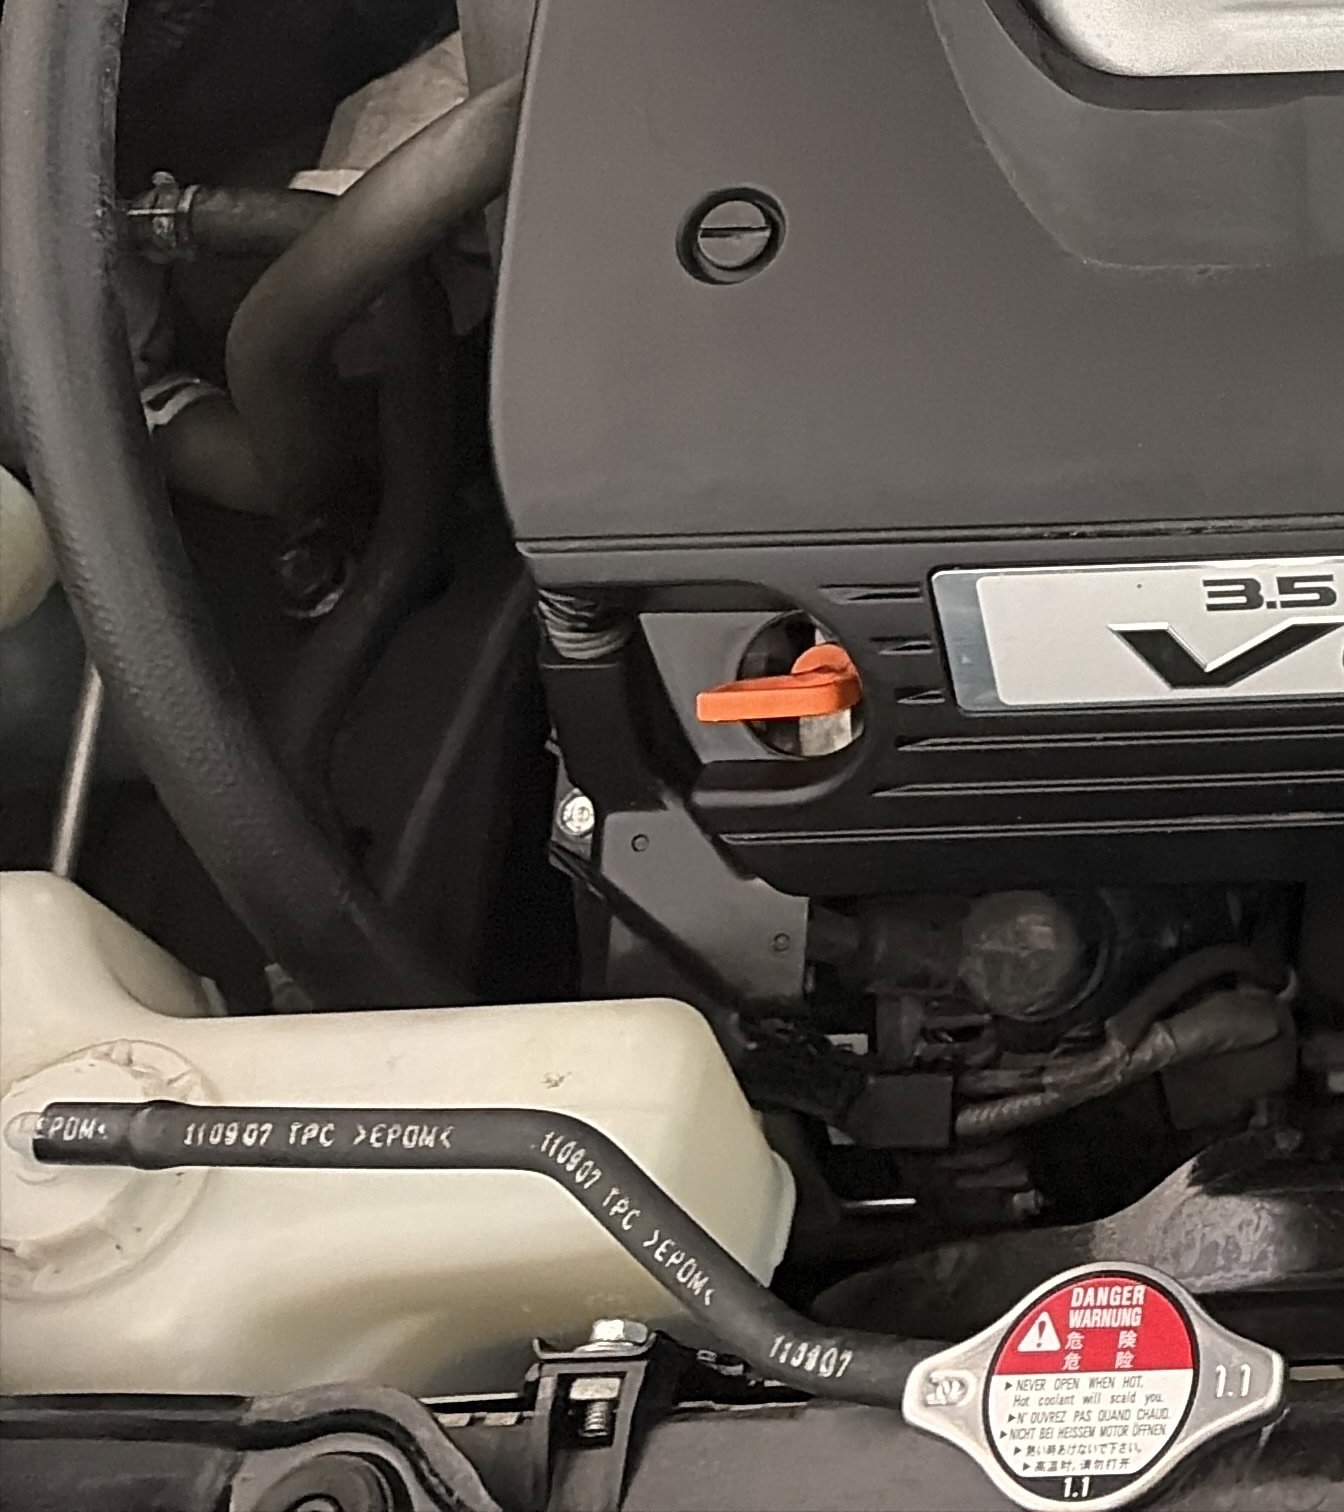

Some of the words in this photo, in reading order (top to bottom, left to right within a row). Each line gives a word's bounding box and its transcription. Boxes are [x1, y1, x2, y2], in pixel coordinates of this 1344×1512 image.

[1202, 574, 1337, 612] 3.5
[183, 1122, 273, 1147] 110907
[288, 1121, 336, 1148] TPC
[541, 1131, 602, 1189] 110907
[602, 1187, 641, 1231] TPC
[1070, 1284, 1146, 1307] DANGER
[1069, 1307, 1143, 1329] WARNUNG
[1016, 1378, 1046, 1391] NEVER
[1054, 1377, 1079, 1390] OPEN
[1088, 1376, 1115, 1389] WHEN
[1215, 1363, 1251, 1398] 1.1
[1013, 1394, 1029, 1407] Hot
[1038, 1393, 1075, 1406] coolant
[1083, 1392, 1102, 1405] will
[1110, 1391, 1136, 1404] scald
[1073, 1409, 1093, 1423] PAS
[1098, 1408, 1131, 1422] QUAND
[1009, 1427, 1036, 1441] NICHT
[1039, 1426, 1054, 1440] BEI
[1057, 1425, 1096, 1439] HEISSEM
[1099, 1424, 1129, 1438] MOTOR
[1063, 1476, 1090, 1498] 1.1
